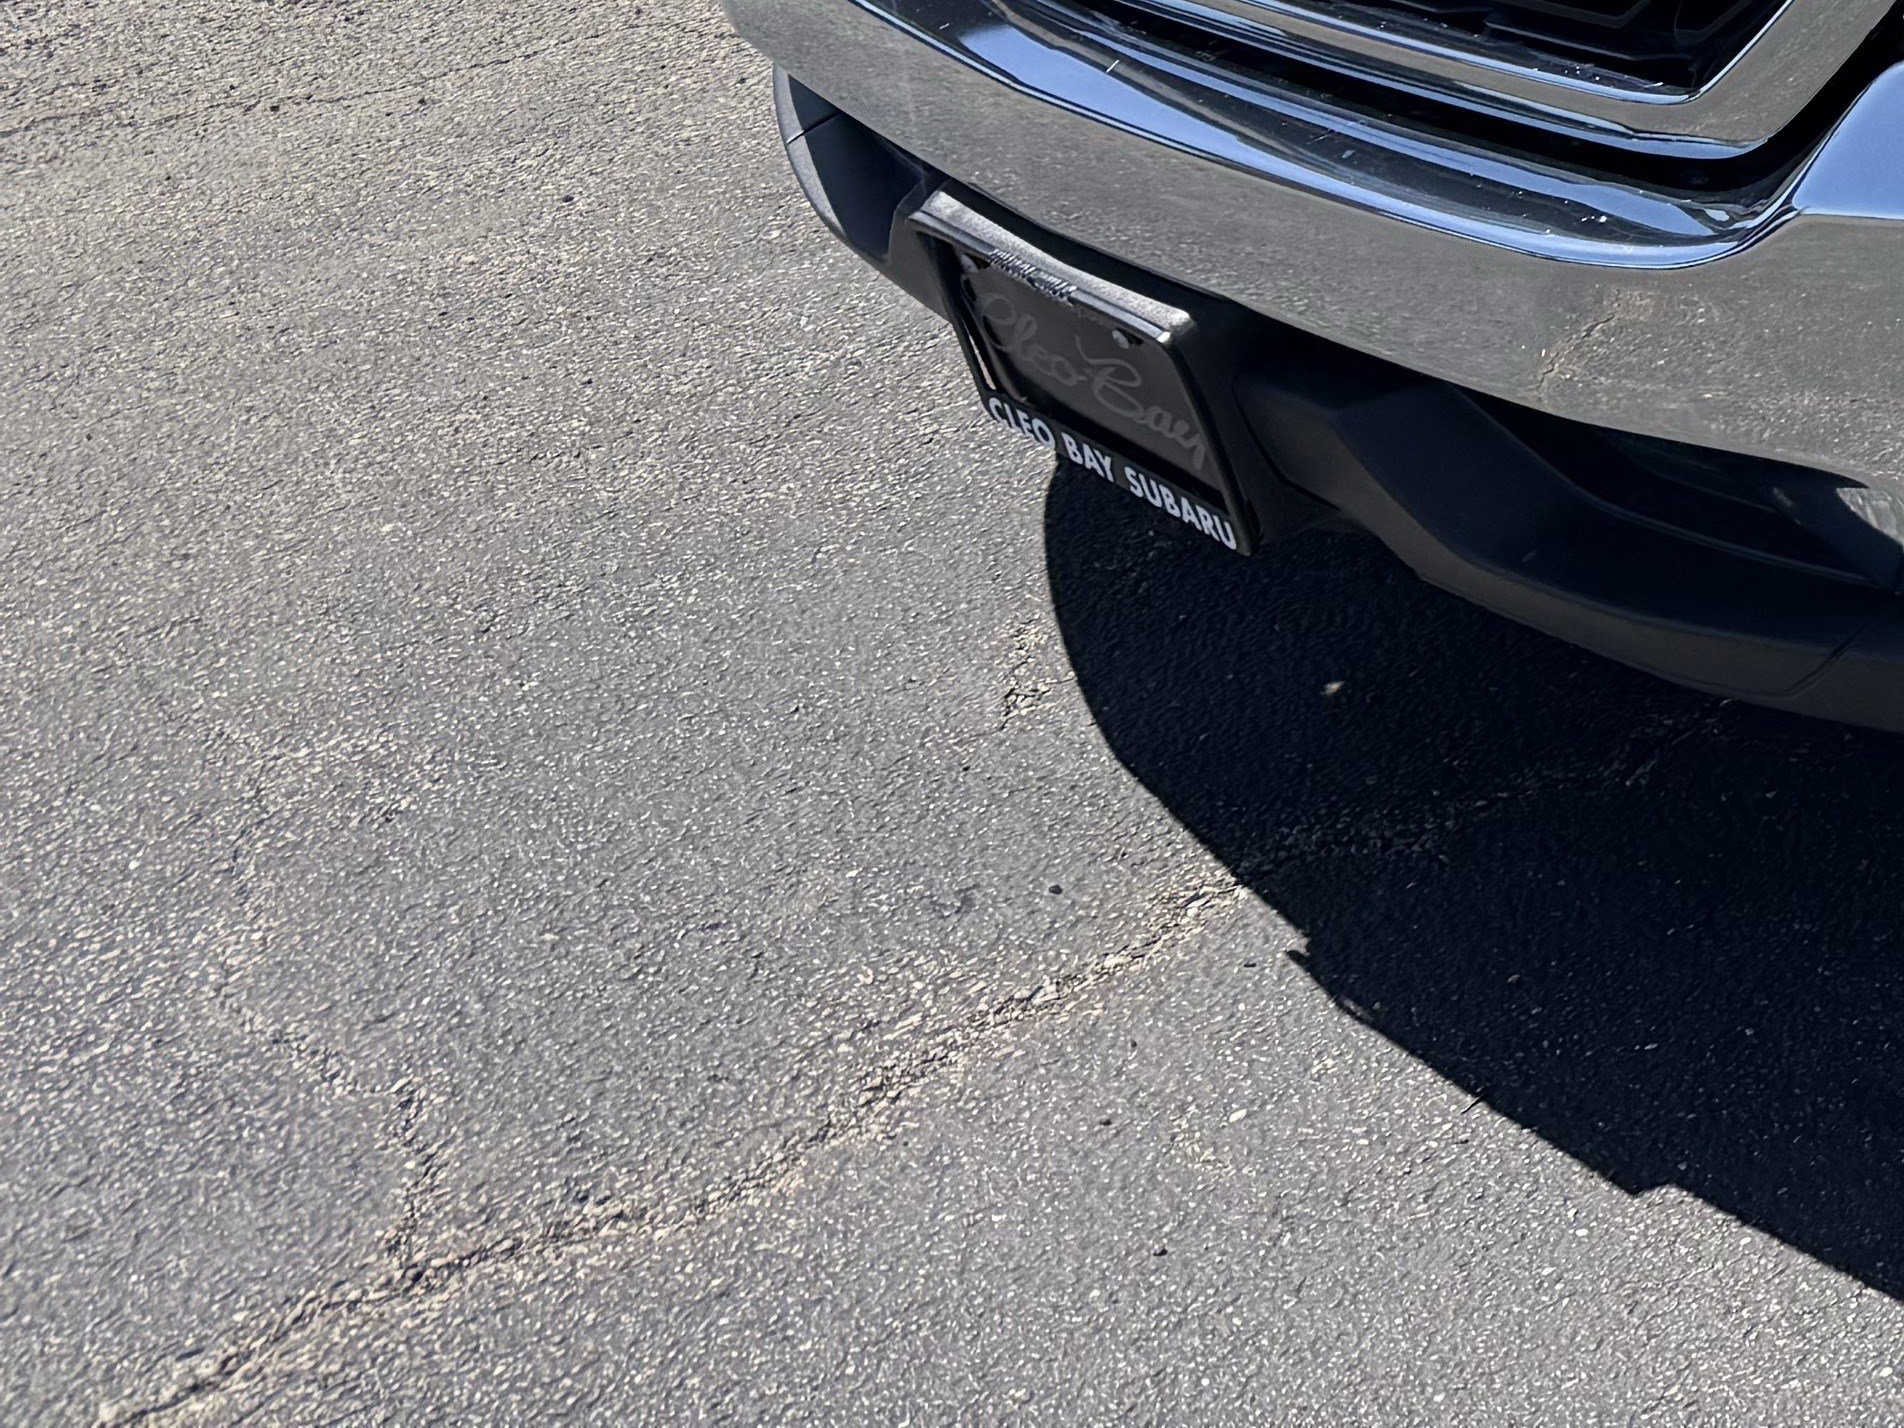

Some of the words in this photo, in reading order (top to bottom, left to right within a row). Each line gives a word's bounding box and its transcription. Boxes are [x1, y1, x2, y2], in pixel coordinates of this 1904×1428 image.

[989, 397, 1056, 449] CLEO
[1062, 431, 1116, 483] BAY
[1124, 466, 1238, 550] SUBARU
